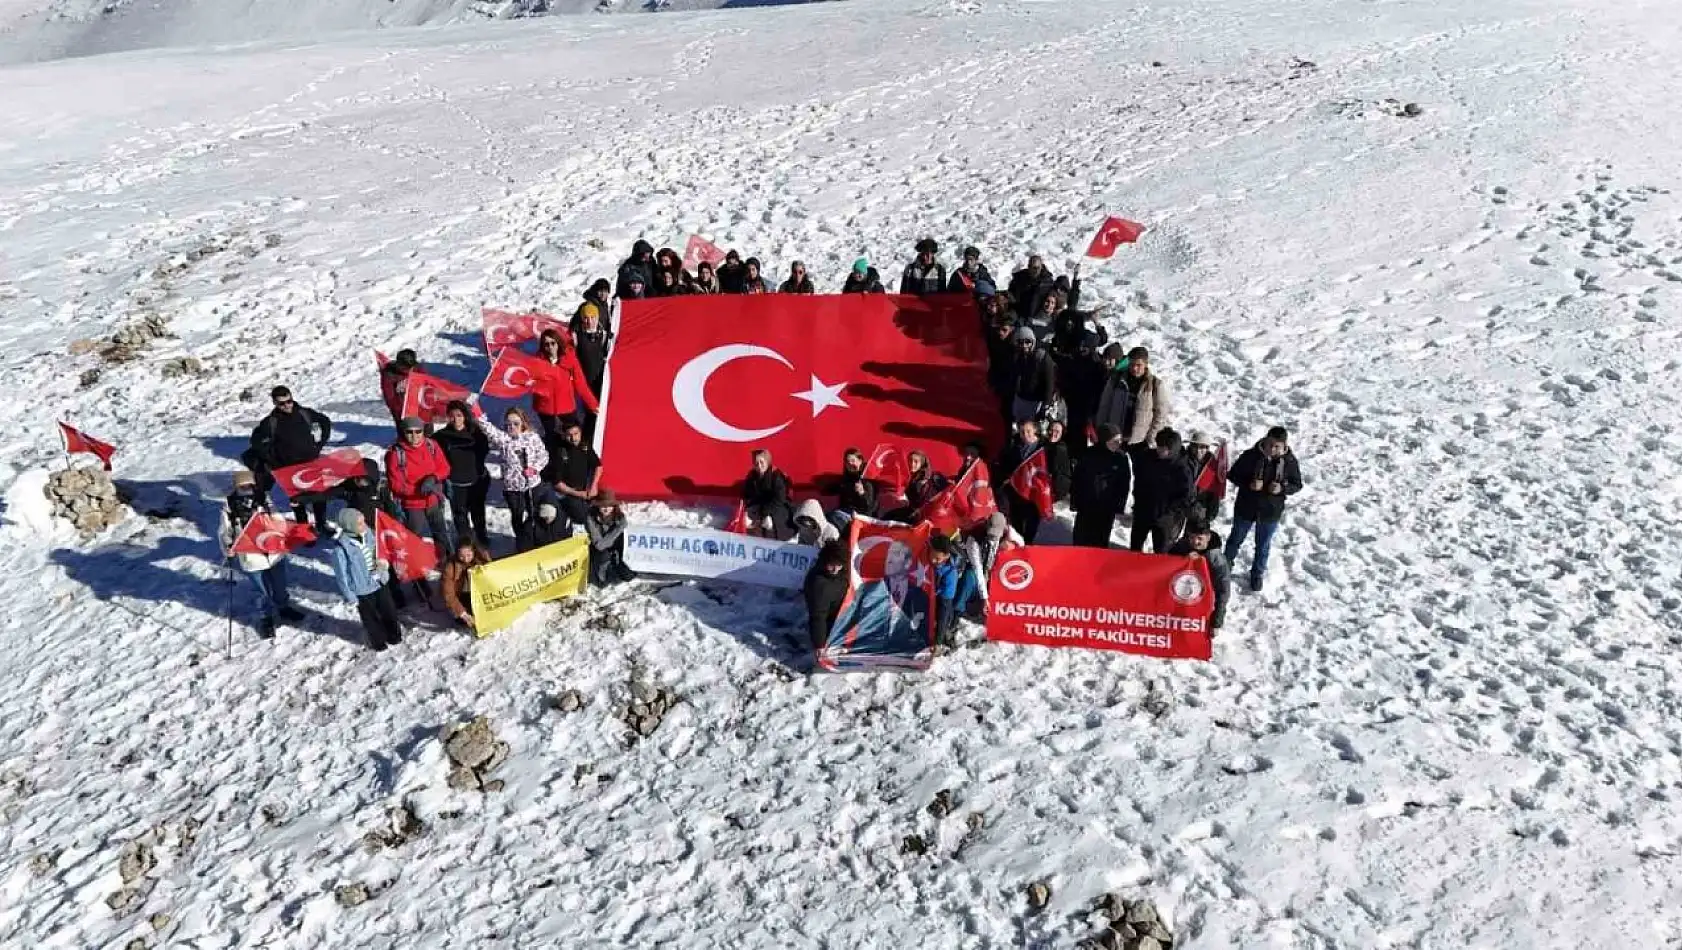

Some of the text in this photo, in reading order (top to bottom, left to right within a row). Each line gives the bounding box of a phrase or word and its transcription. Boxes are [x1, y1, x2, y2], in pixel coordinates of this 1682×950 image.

[627, 534, 747, 560] PAPHLAGONIA
[481, 575, 539, 605] ENGLISH
[547, 559, 579, 581] TIME
[995, 602, 1206, 632] KASTAMONU ÜNİVERSİTESİ
[1025, 622, 1171, 648] TURİZM FAKÜLTESİ
